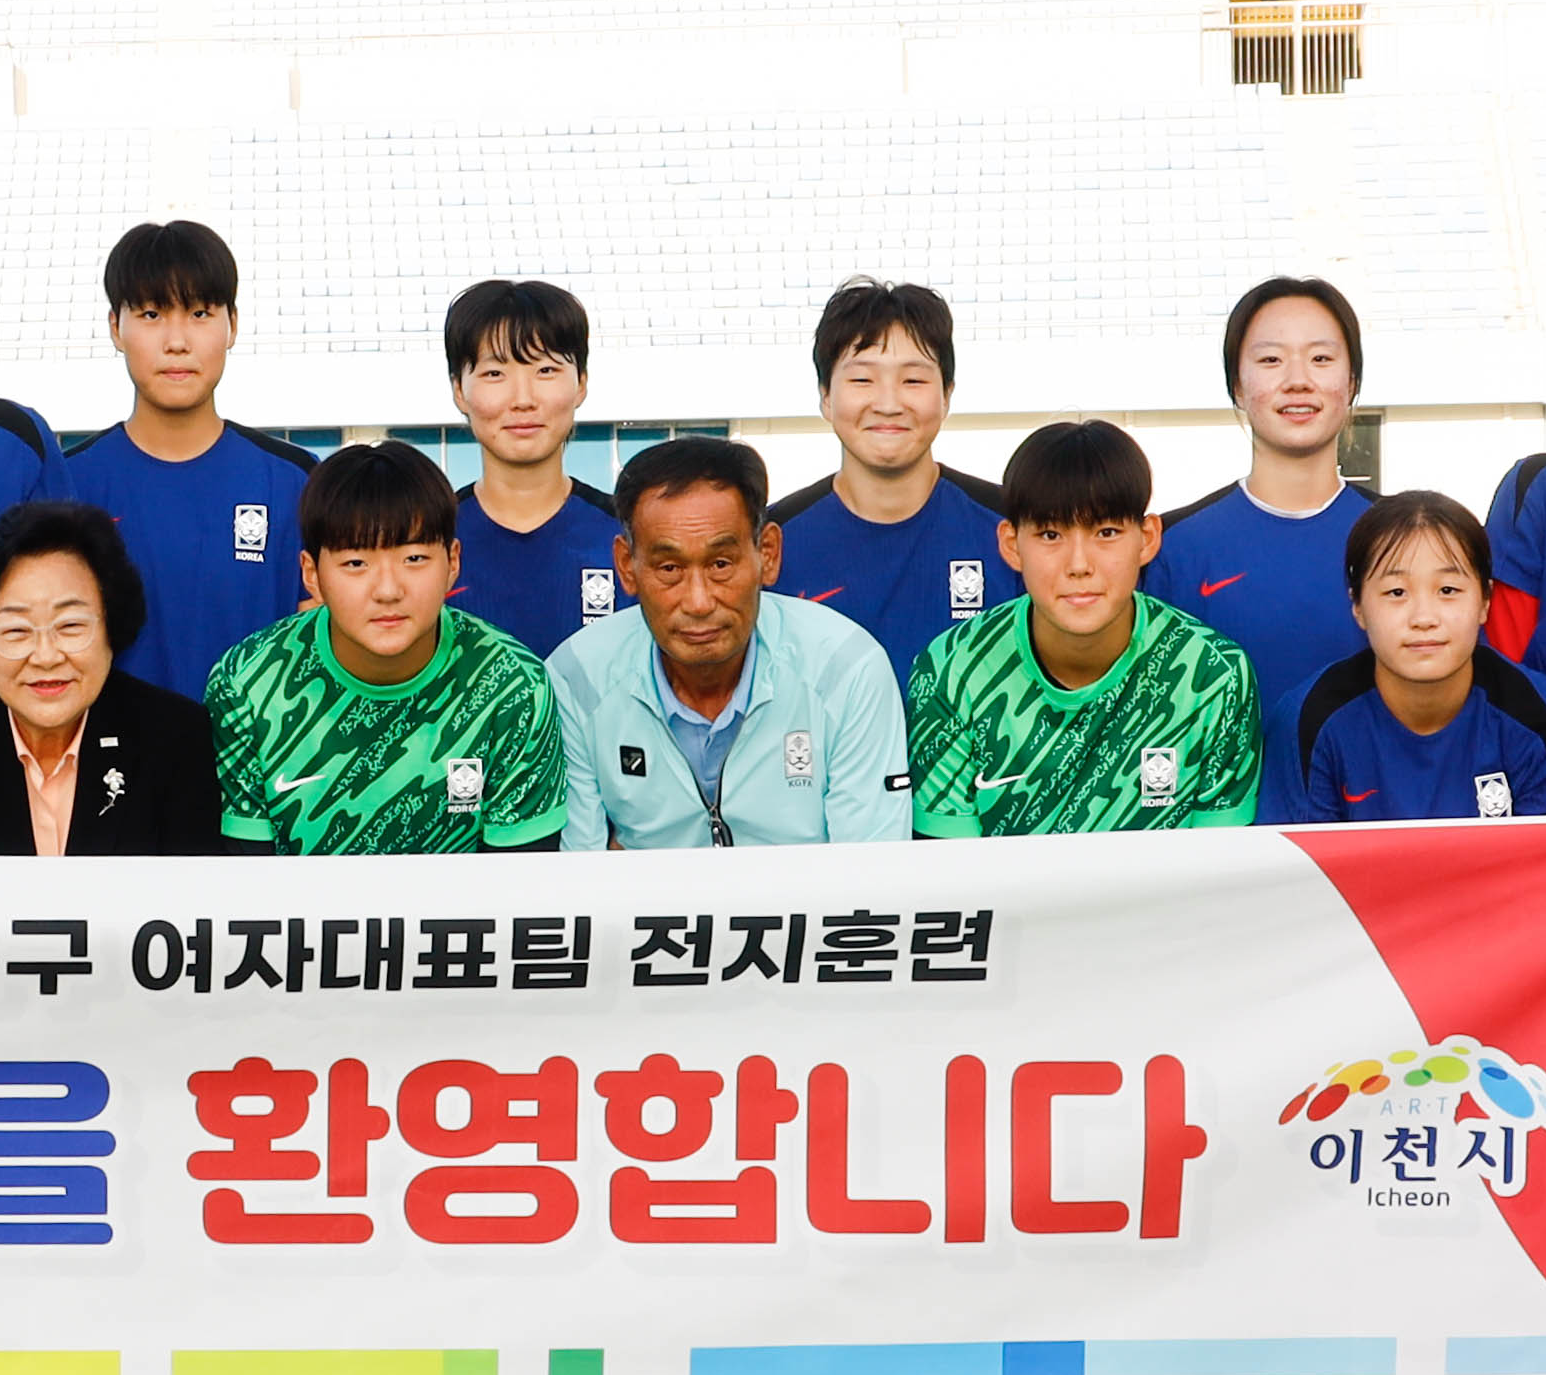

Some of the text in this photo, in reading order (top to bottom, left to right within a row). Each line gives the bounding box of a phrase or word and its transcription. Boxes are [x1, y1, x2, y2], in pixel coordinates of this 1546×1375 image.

[235, 551, 265, 563] KOREA
[448, 803, 481, 813] KOREA
[1141, 797, 1176, 808] KOREA
[130, 915, 593, 995] 여자대표팀
[630, 909, 994, 987] 전지훈련
[186, 1053, 1208, 1244] 환영합니다
[1367, 1187, 1450, 1207] Icheon
